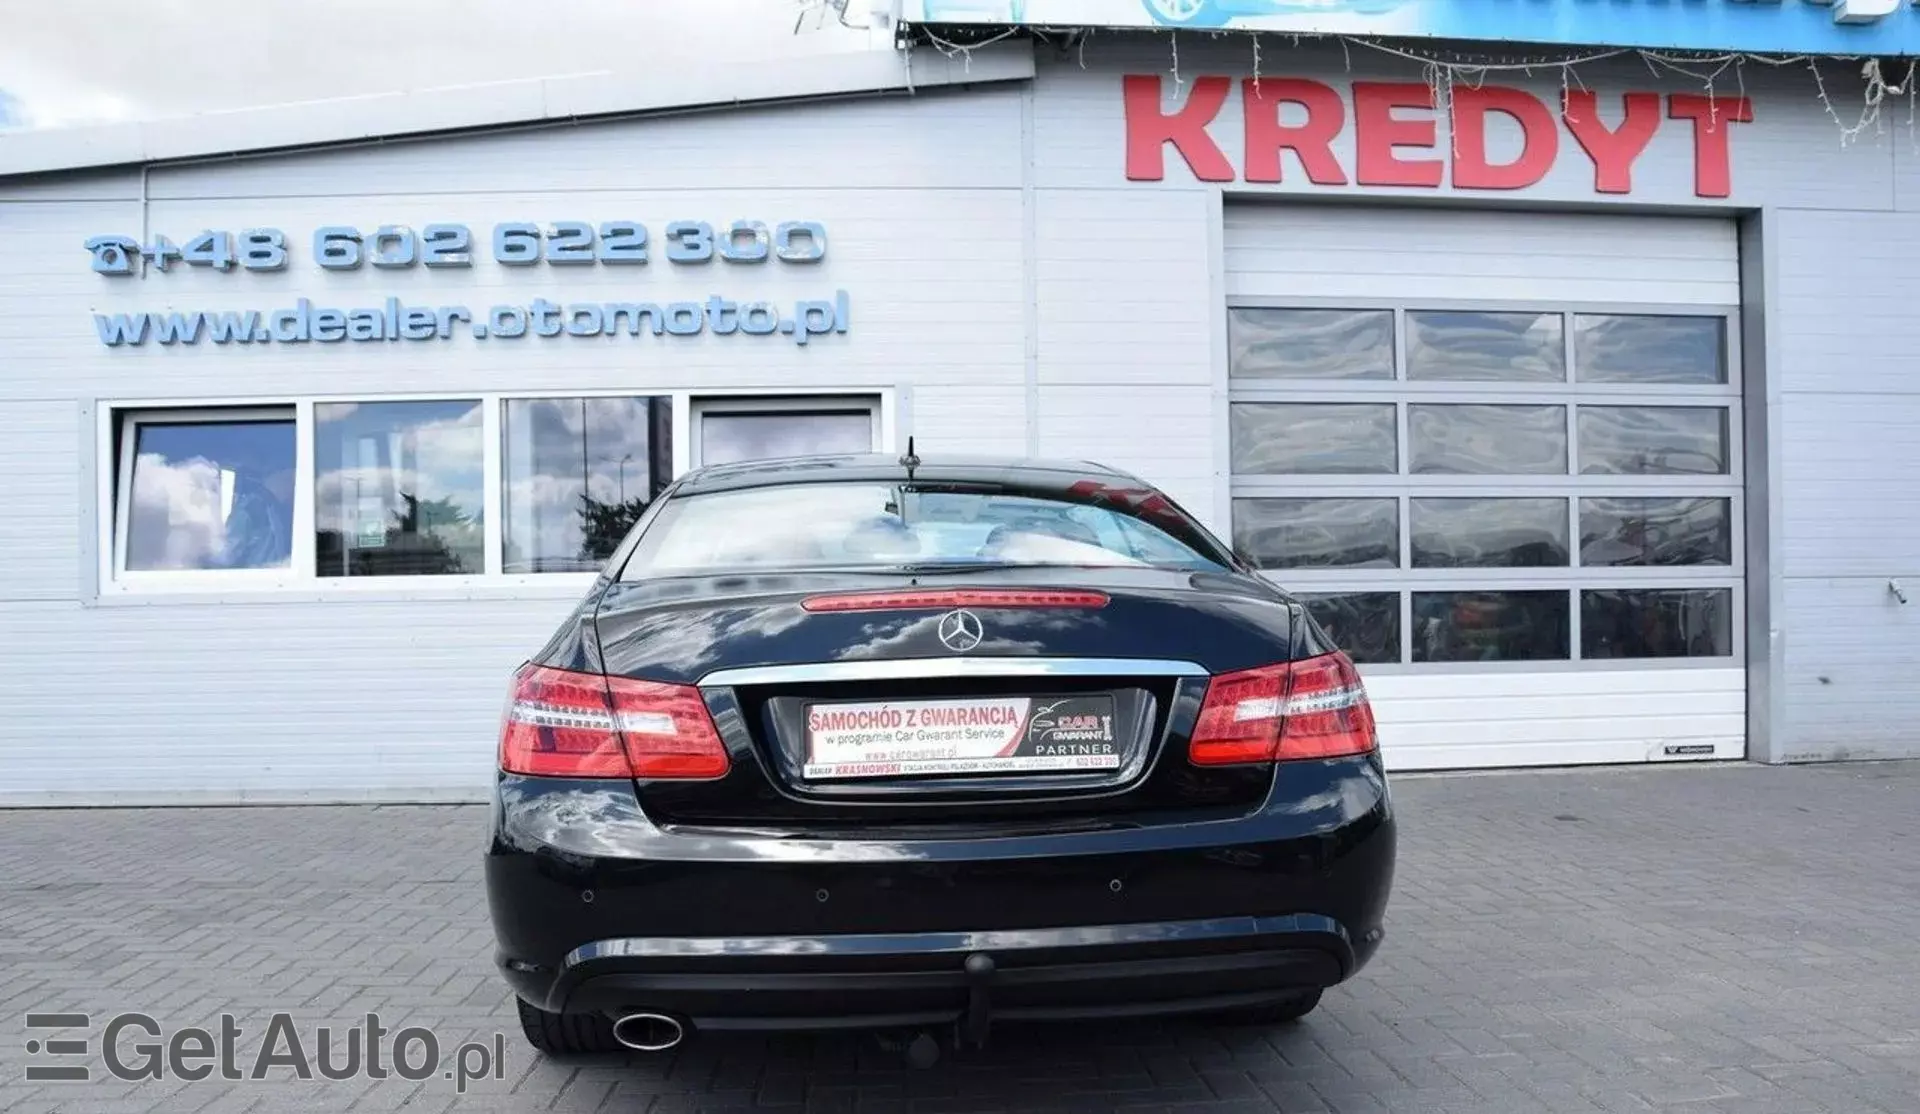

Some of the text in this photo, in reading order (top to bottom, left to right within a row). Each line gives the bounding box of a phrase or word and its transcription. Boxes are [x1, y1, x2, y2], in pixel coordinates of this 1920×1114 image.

[1124, 74, 1752, 197] KREDYT
[140, 219, 827, 272] +48 602 622 300
[92, 288, 850, 347] www.dealer.otomoto.pl
[811, 705, 1020, 731] SAMOCHÓD Z GWARANCJĄ
[826, 728, 1005, 746] w programie Car Gwarant Service
[1035, 744, 1112, 755] PARTNER
[835, 763, 900, 775] KRASNOWSKI
